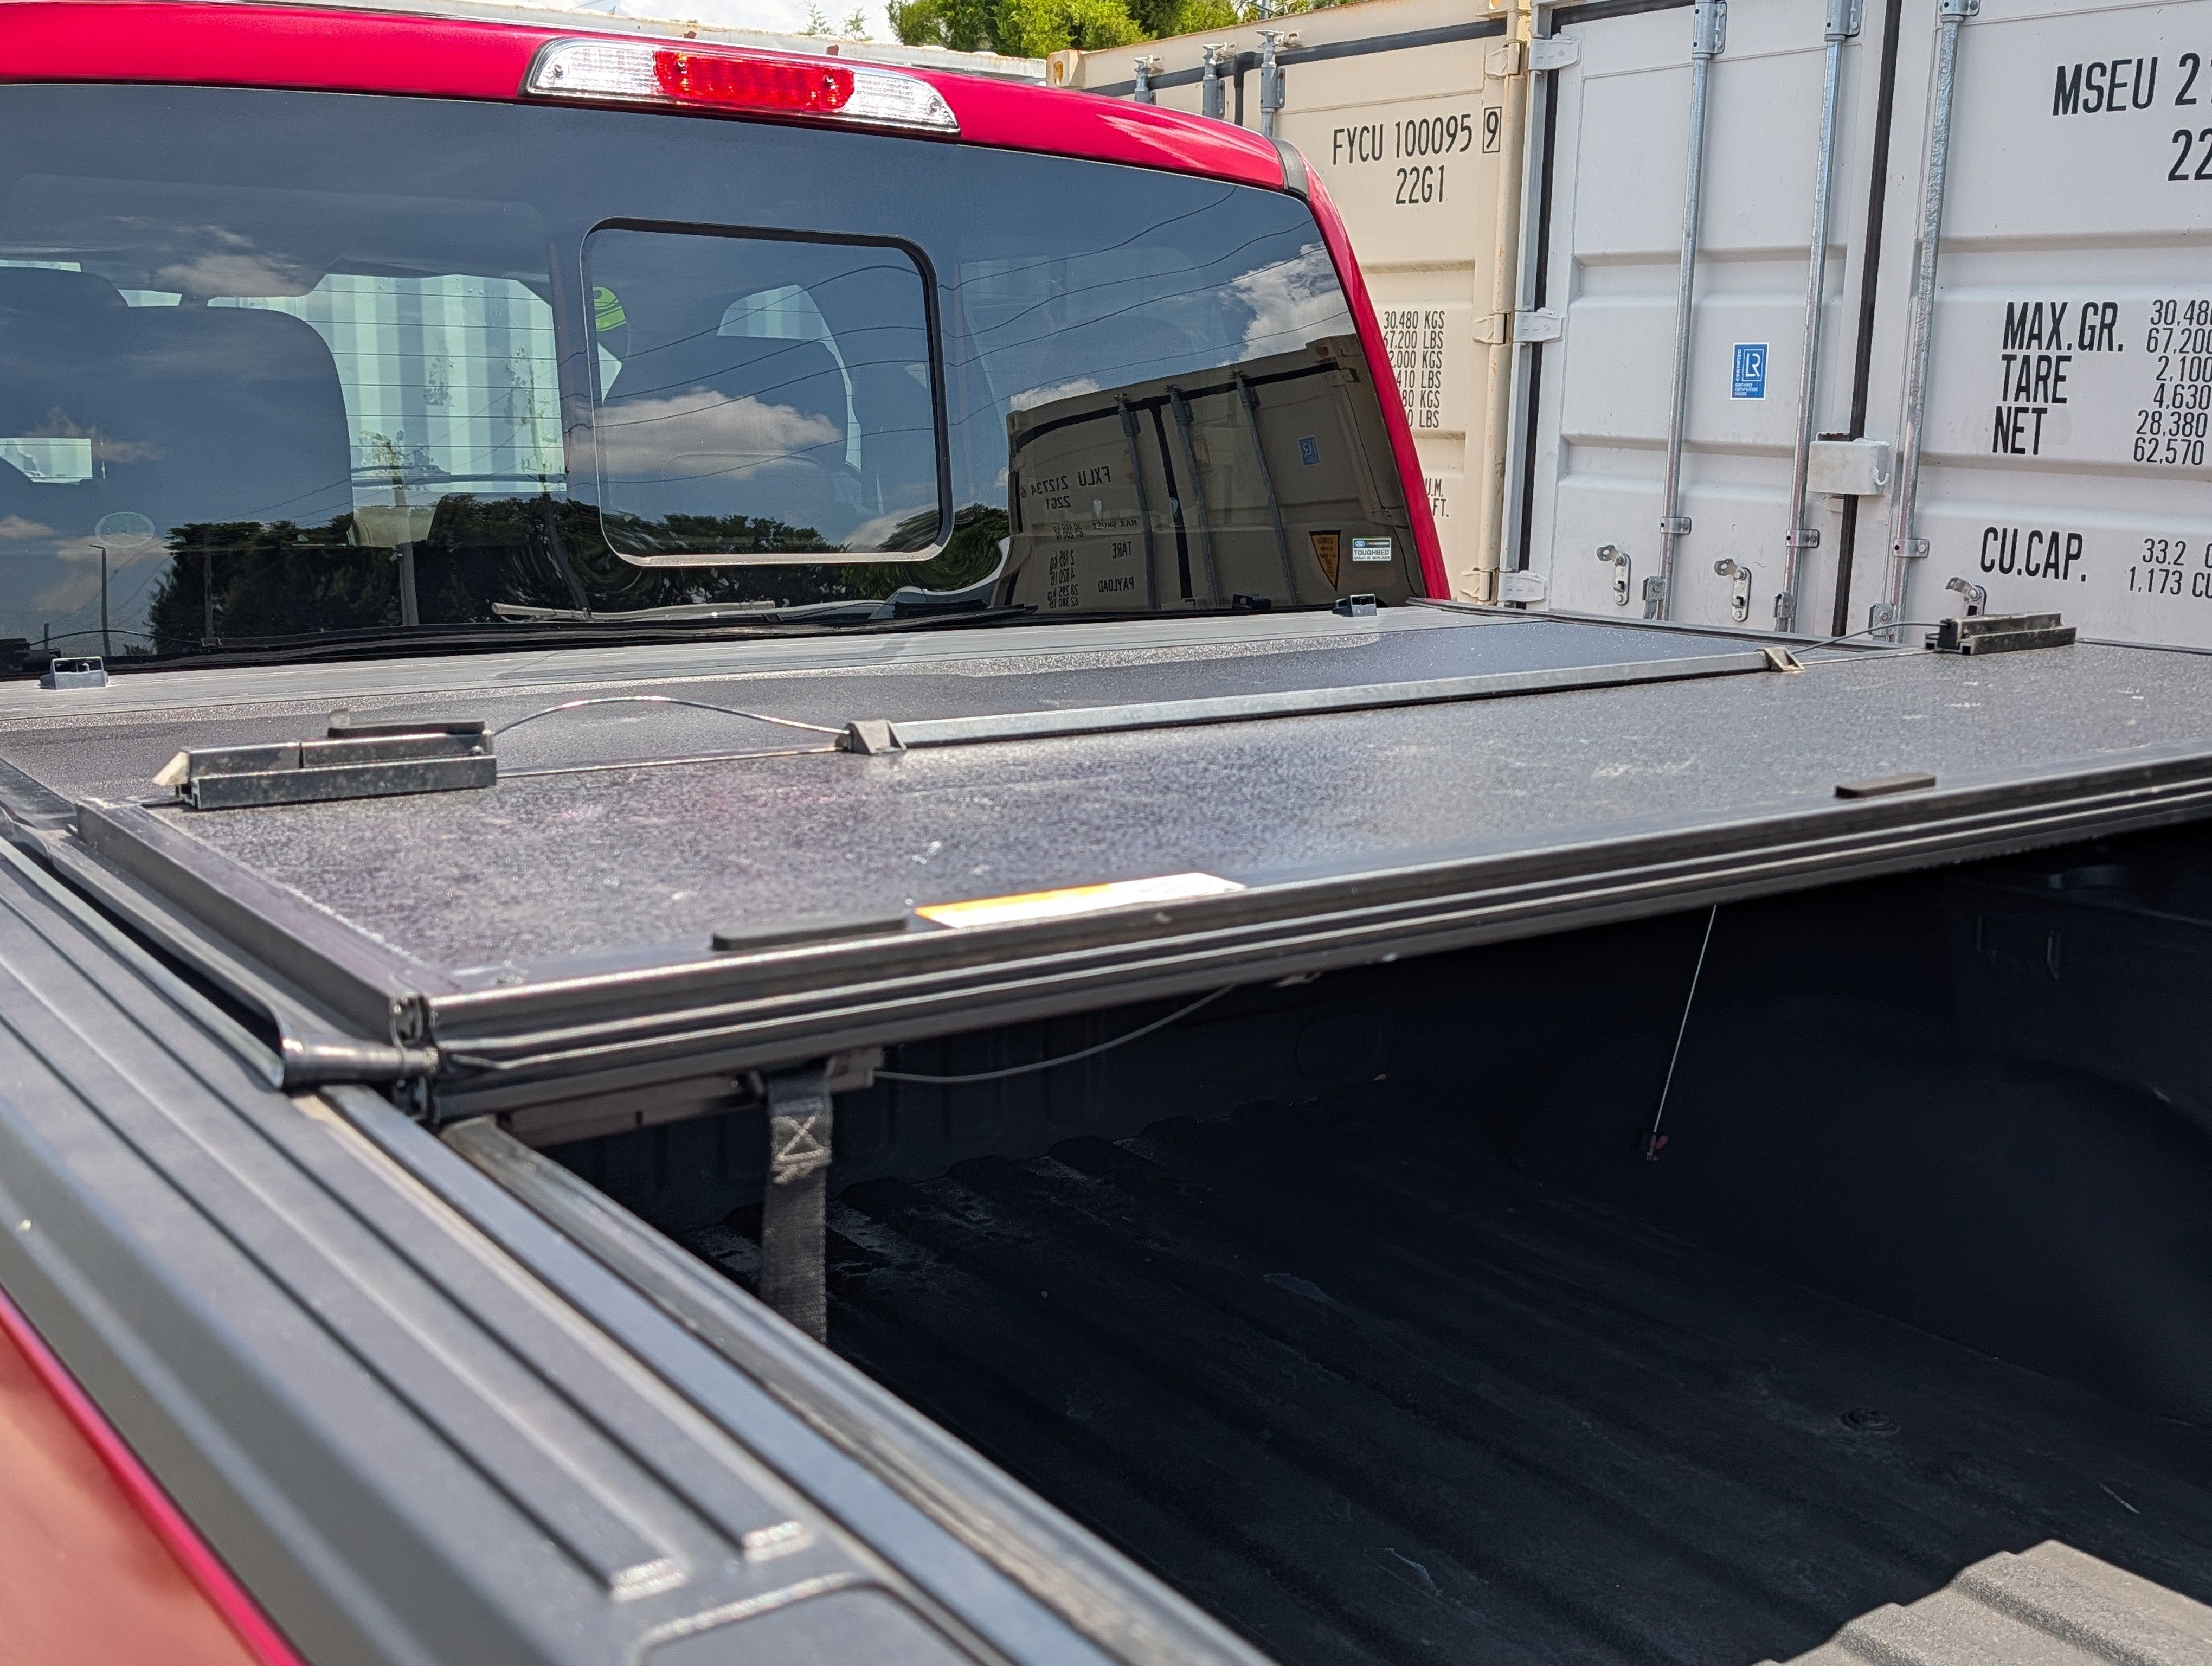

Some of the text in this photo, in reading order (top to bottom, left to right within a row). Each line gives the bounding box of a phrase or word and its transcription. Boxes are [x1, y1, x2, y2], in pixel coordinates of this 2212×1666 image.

[2053, 53, 2212, 116] MSEU 2
[1333, 111, 1499, 165] FYCU 100095 9
[1396, 165, 1444, 204] 22G1
[1424, 311, 1445, 329] KGS
[2002, 299, 2212, 352] MAX.GR. 30,48
[1423, 330, 1443, 349] LBS
[1422, 350, 1442, 368] KGS
[1746, 353, 1760, 377] LR
[1421, 370, 1441, 389] LBS
[2002, 354, 2072, 404] TARE
[1401, 389, 1440, 408] 80 KGS
[2153, 383, 2211, 410] 4,630
[1419, 410, 1439, 428] LBS
[1992, 406, 2208, 456] NET 28,380
[2134, 437, 2204, 465] 62,570
[1980, 526, 2087, 582] CU.CAP.
[2143, 538, 2186, 566] 33.2
